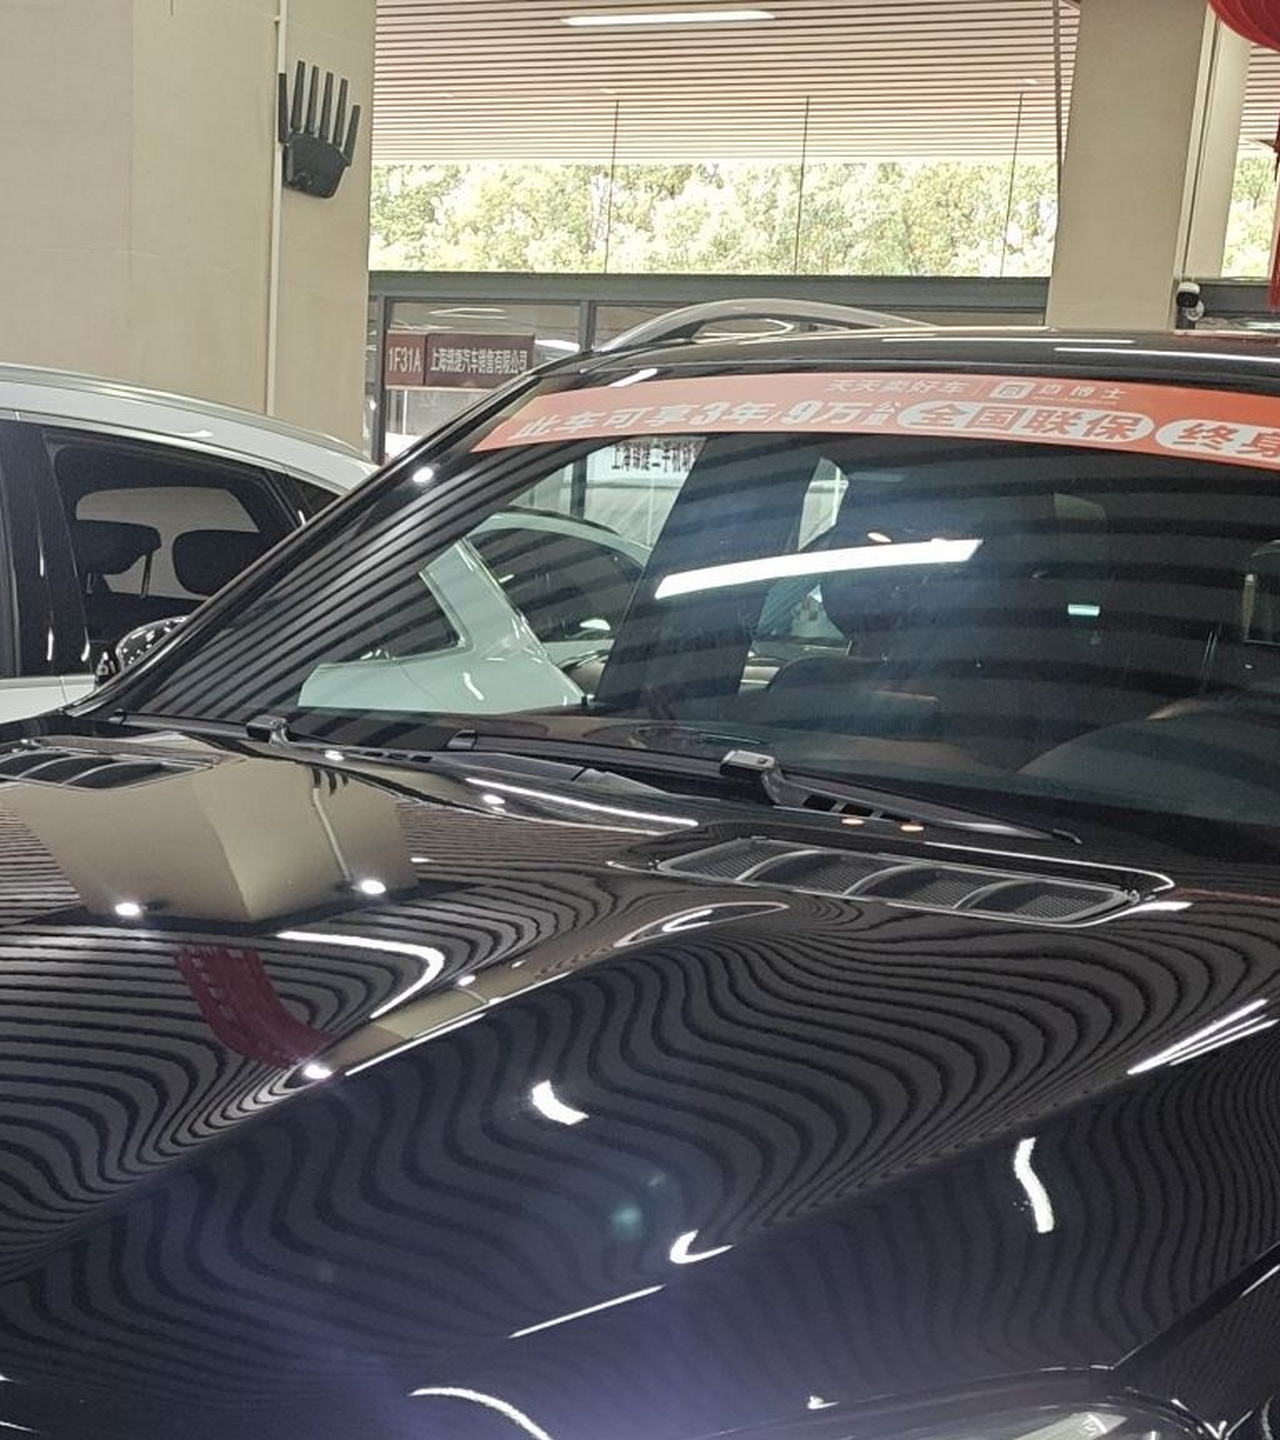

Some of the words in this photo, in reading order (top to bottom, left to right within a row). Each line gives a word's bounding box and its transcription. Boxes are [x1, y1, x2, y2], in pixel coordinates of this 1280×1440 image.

[388, 346, 421, 372] 1F31A
[909, 403, 1141, 441] 全国联保
